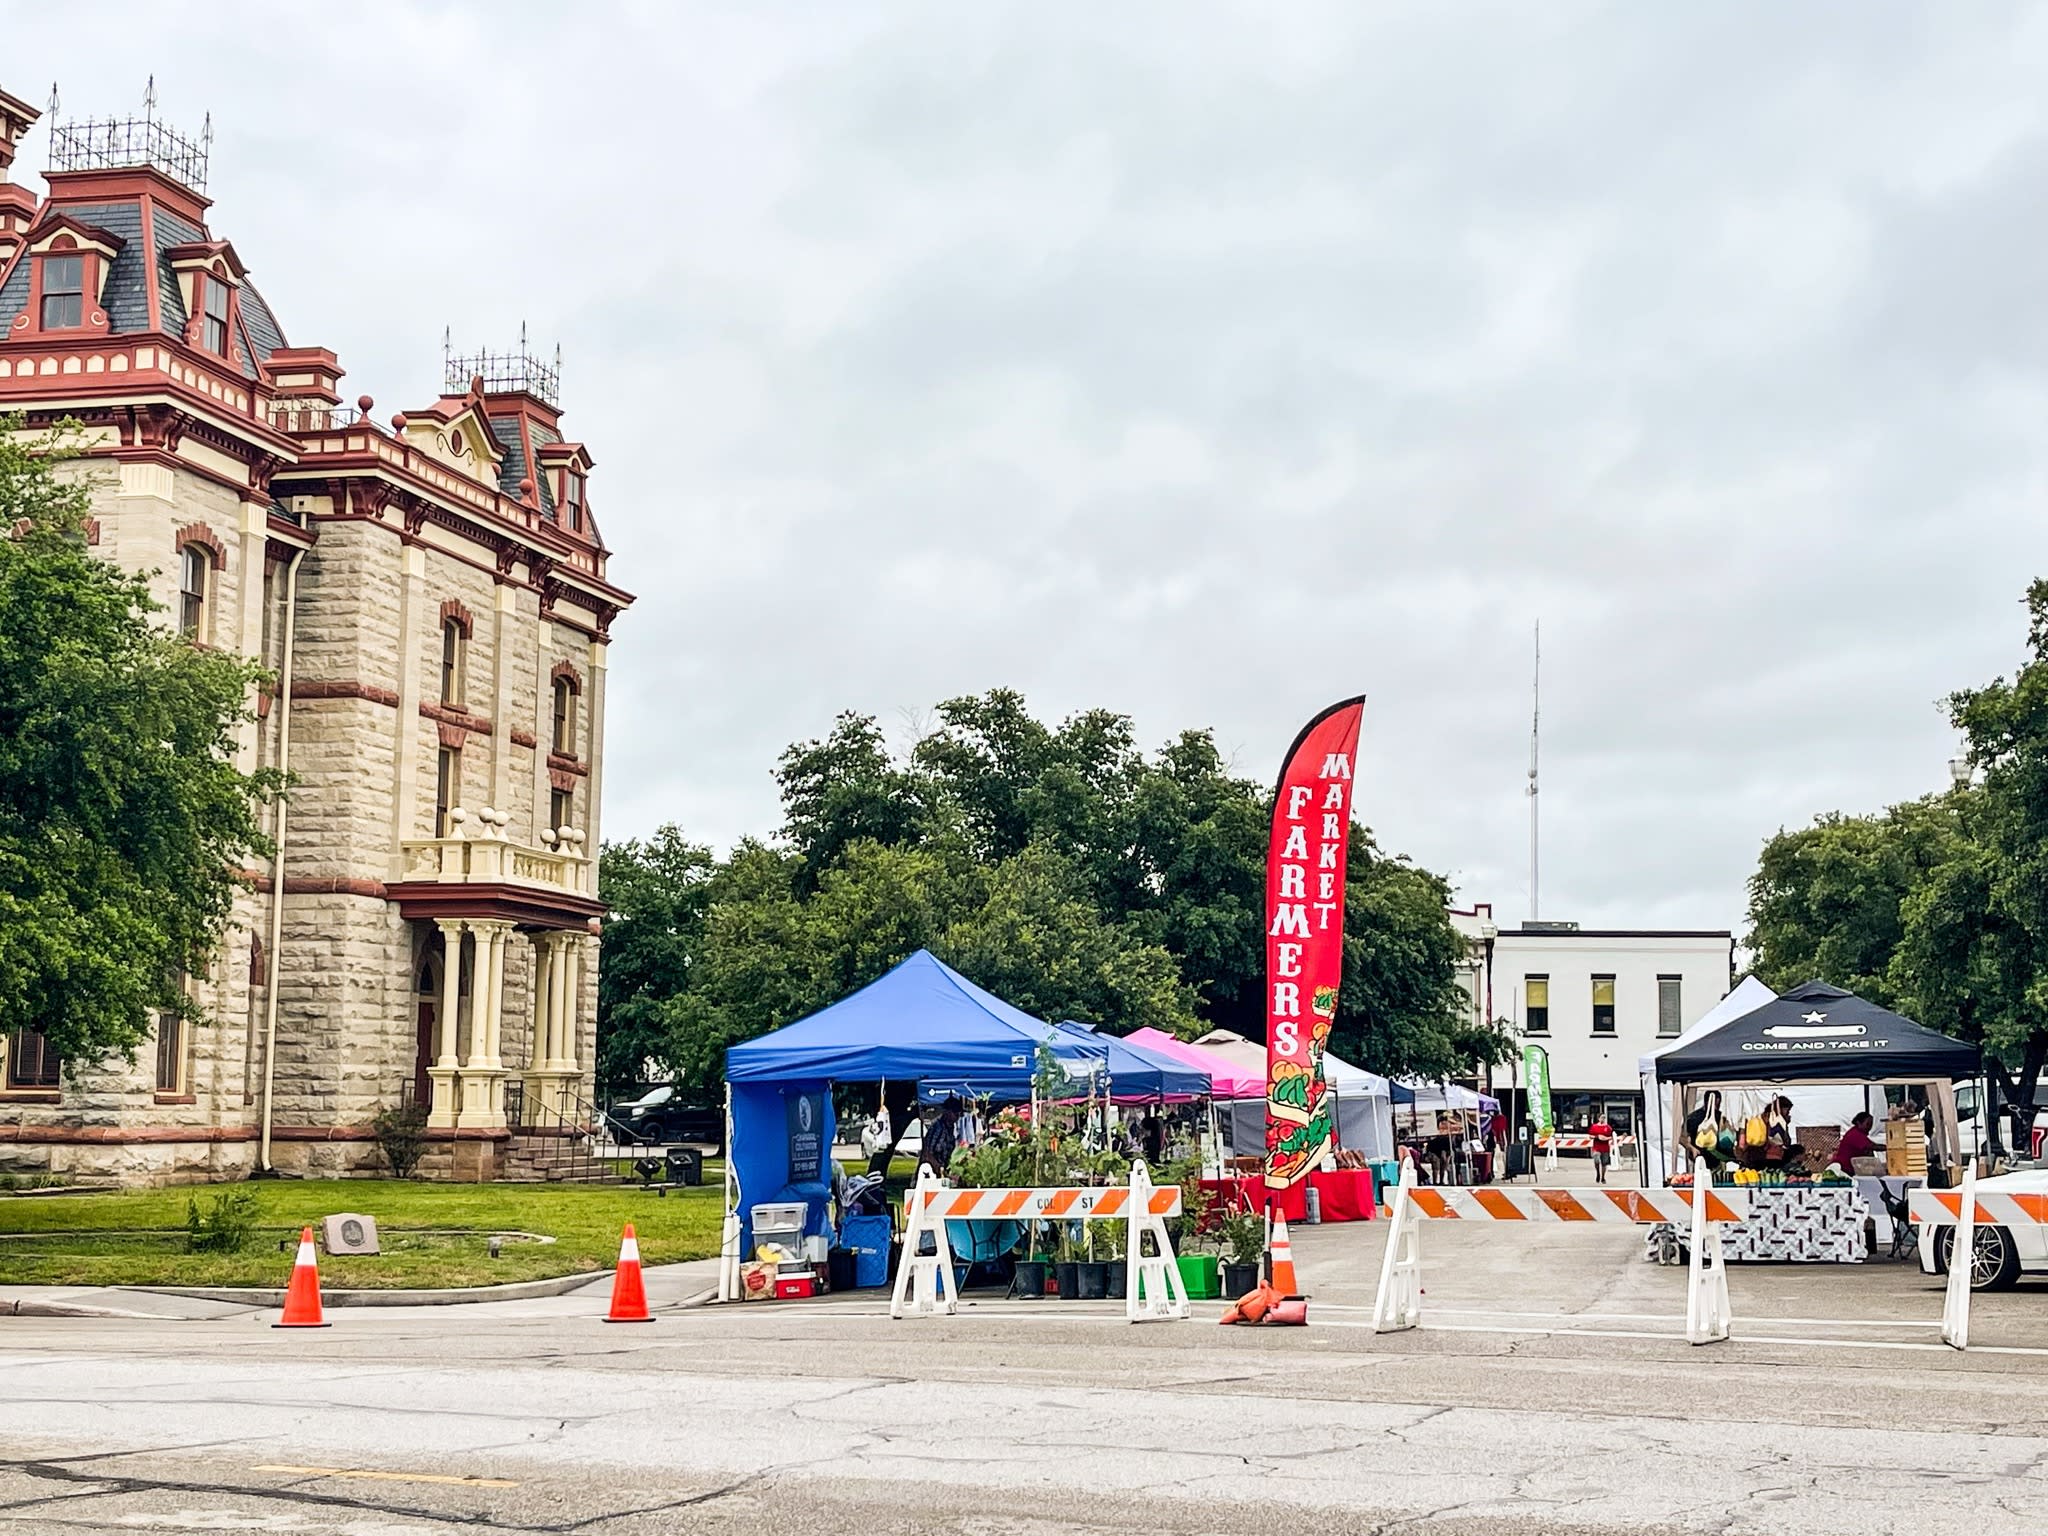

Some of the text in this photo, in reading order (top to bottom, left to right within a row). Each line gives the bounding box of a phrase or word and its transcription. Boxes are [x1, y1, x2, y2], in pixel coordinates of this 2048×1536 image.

[1313, 753, 1352, 930] MARKET
[1269, 786, 1313, 1056] FARMERS
[1741, 1039, 1889, 1051] COME AND TAKE IT
[1081, 1197, 1094, 1209] ST
